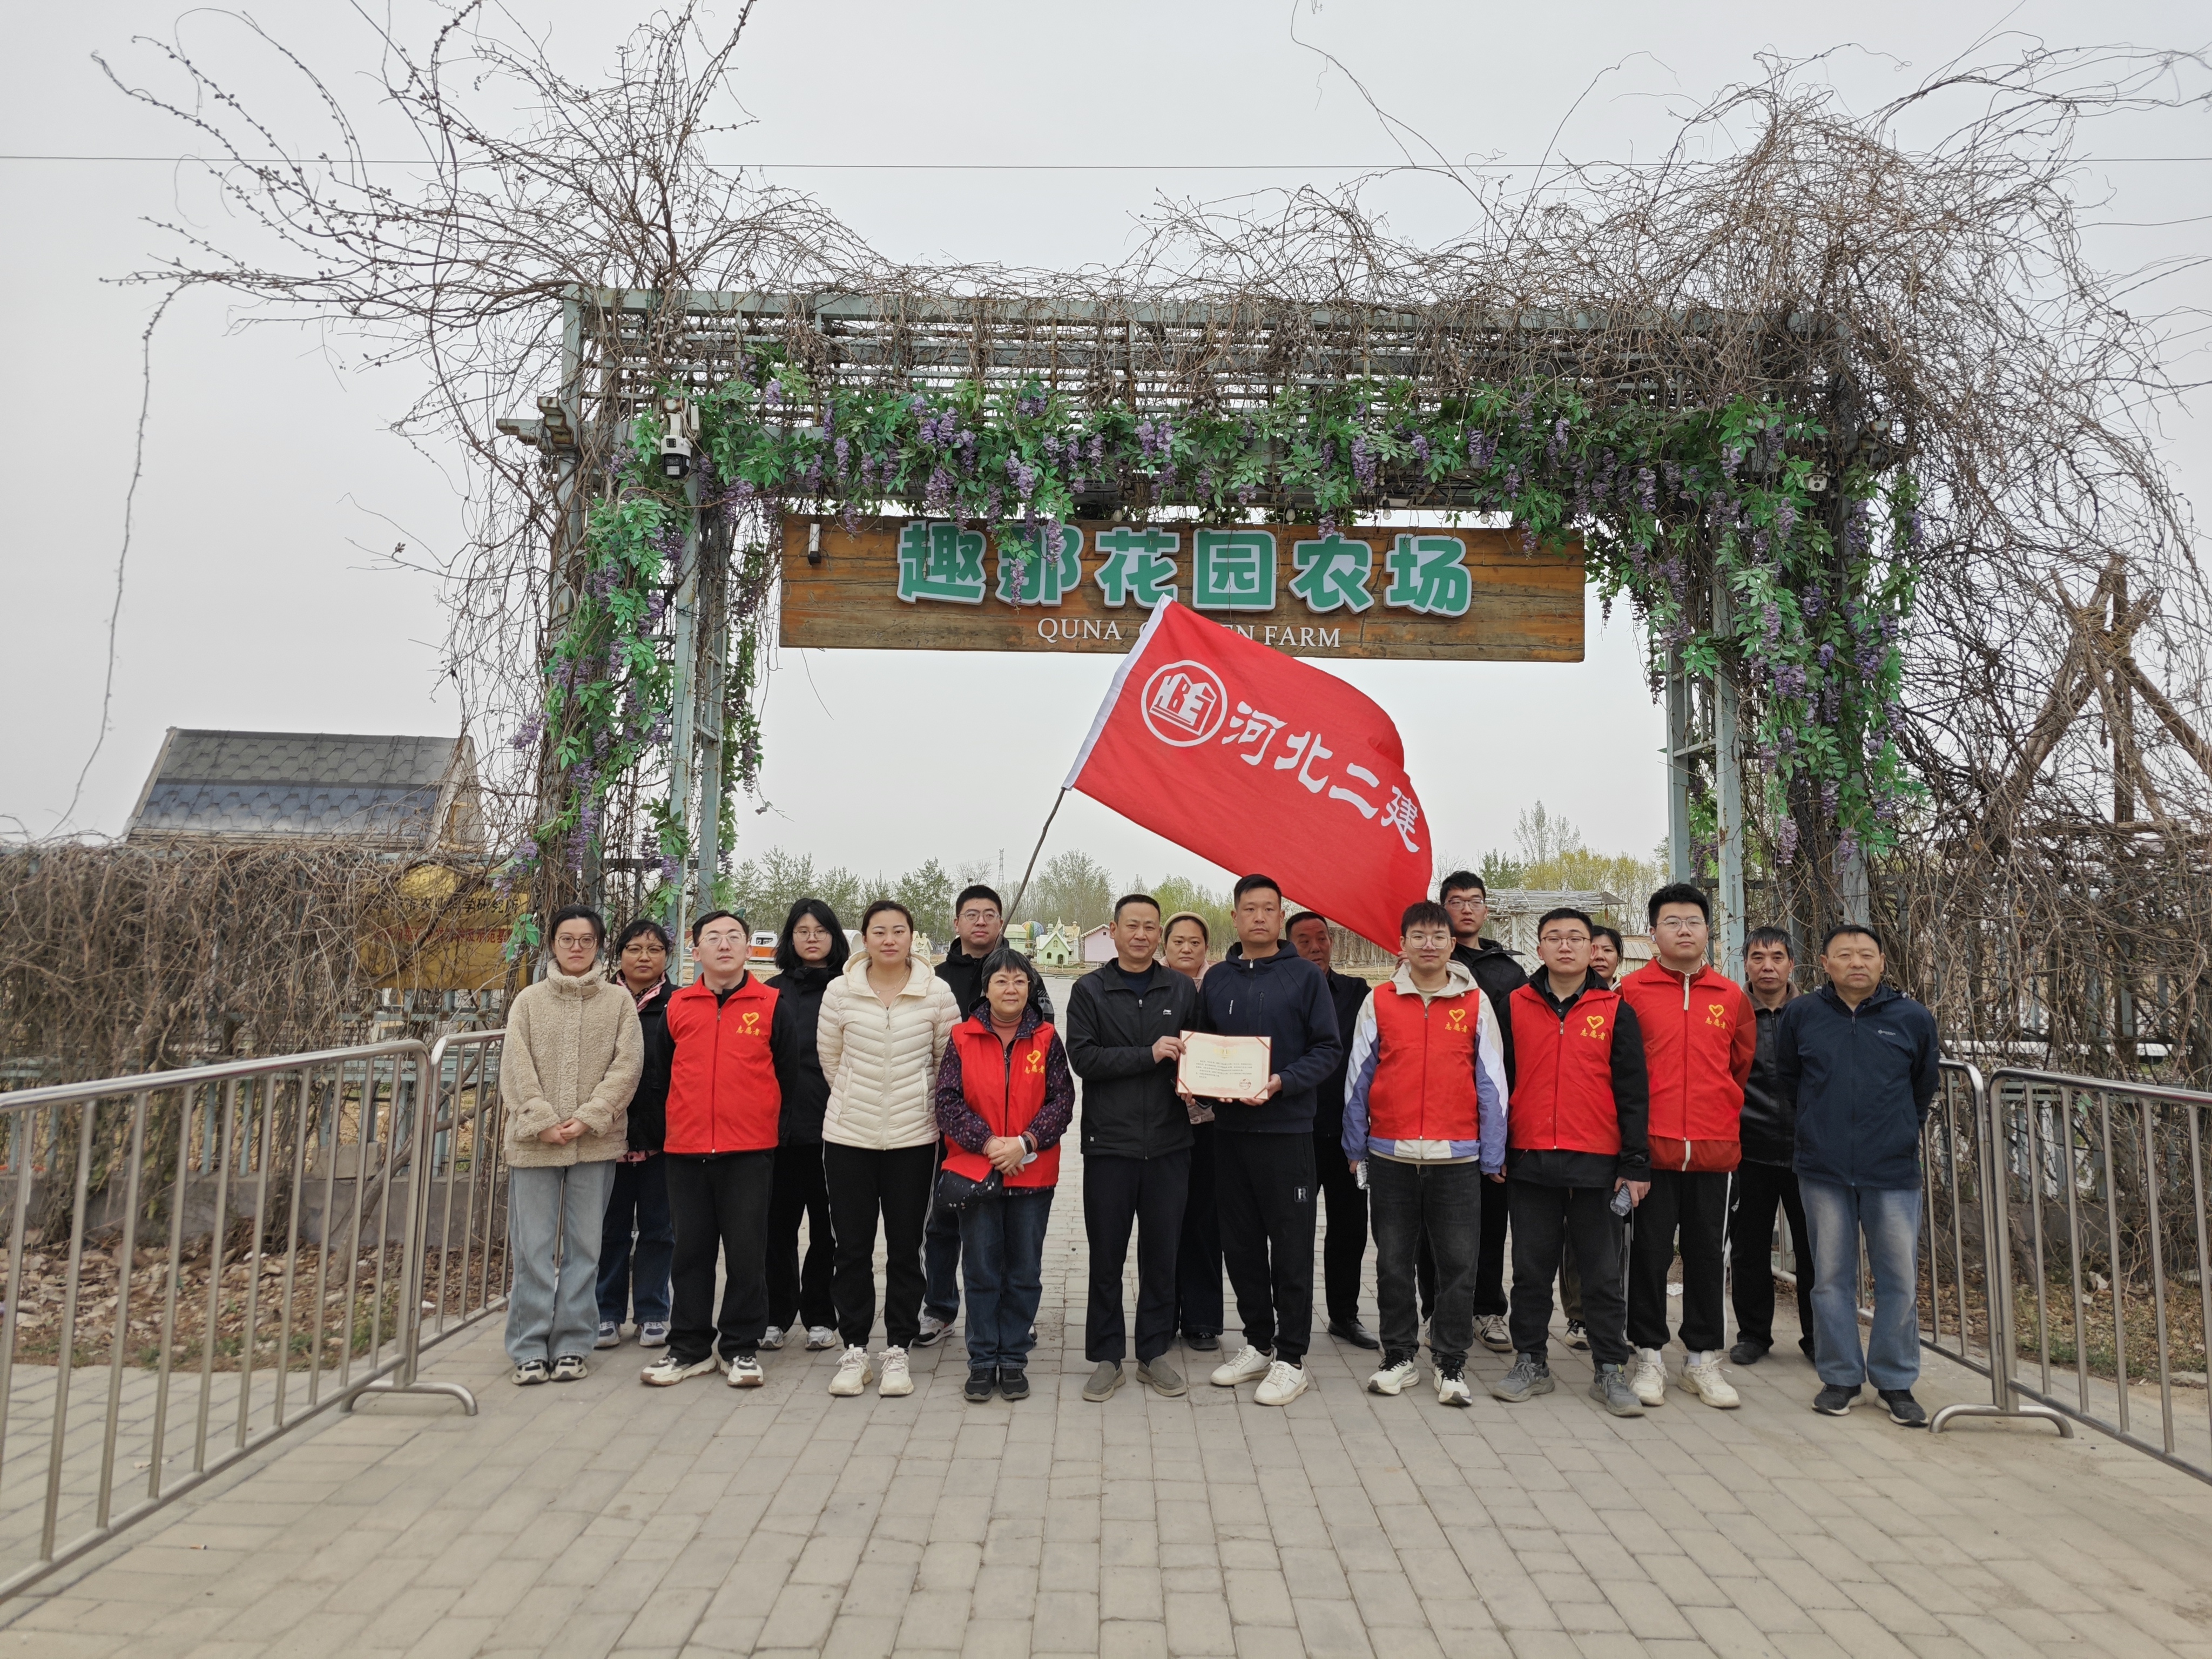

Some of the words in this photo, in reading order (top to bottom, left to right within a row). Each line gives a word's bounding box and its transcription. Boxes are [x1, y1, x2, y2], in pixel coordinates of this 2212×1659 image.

[896, 520, 1472, 618] 趣那花园农场
[1037, 618, 1122, 643] QUNA
[1264, 625, 1341, 648] FARM
[1221, 701, 1420, 852] 河北二建
